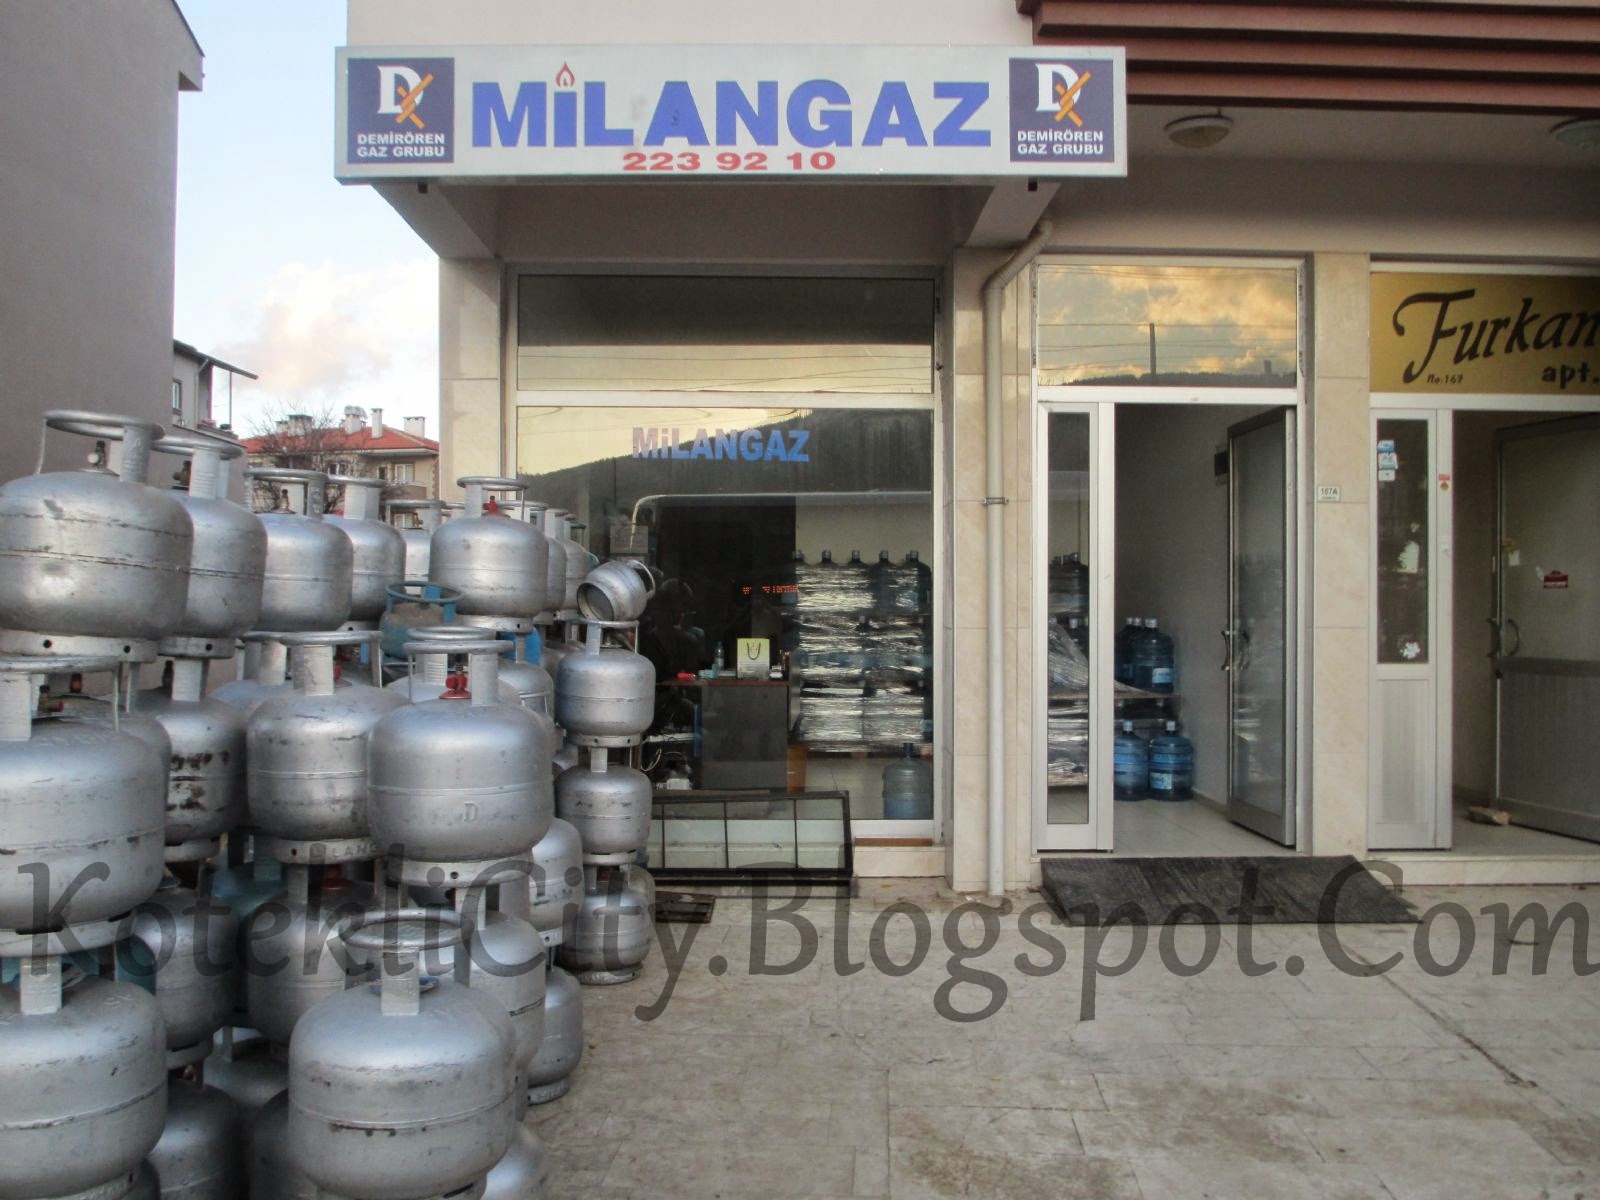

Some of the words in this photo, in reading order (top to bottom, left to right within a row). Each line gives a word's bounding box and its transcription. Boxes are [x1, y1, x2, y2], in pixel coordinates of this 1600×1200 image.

[357, 131, 445, 145] DEMİRÖREN
[1017, 129, 1104, 142] DEMİRÖREN
[357, 146, 388, 157] GAZ
[393, 146, 445, 157] GRUBU
[1017, 143, 1048, 155] GAZ
[1053, 143, 1104, 155] GRUBU
[622, 152, 701, 171] 223
[716, 152, 768, 171] 92
[786, 152, 836, 170] 10
[1392, 288, 1600, 384] Furkan
[1542, 362, 1600, 389] apt.
